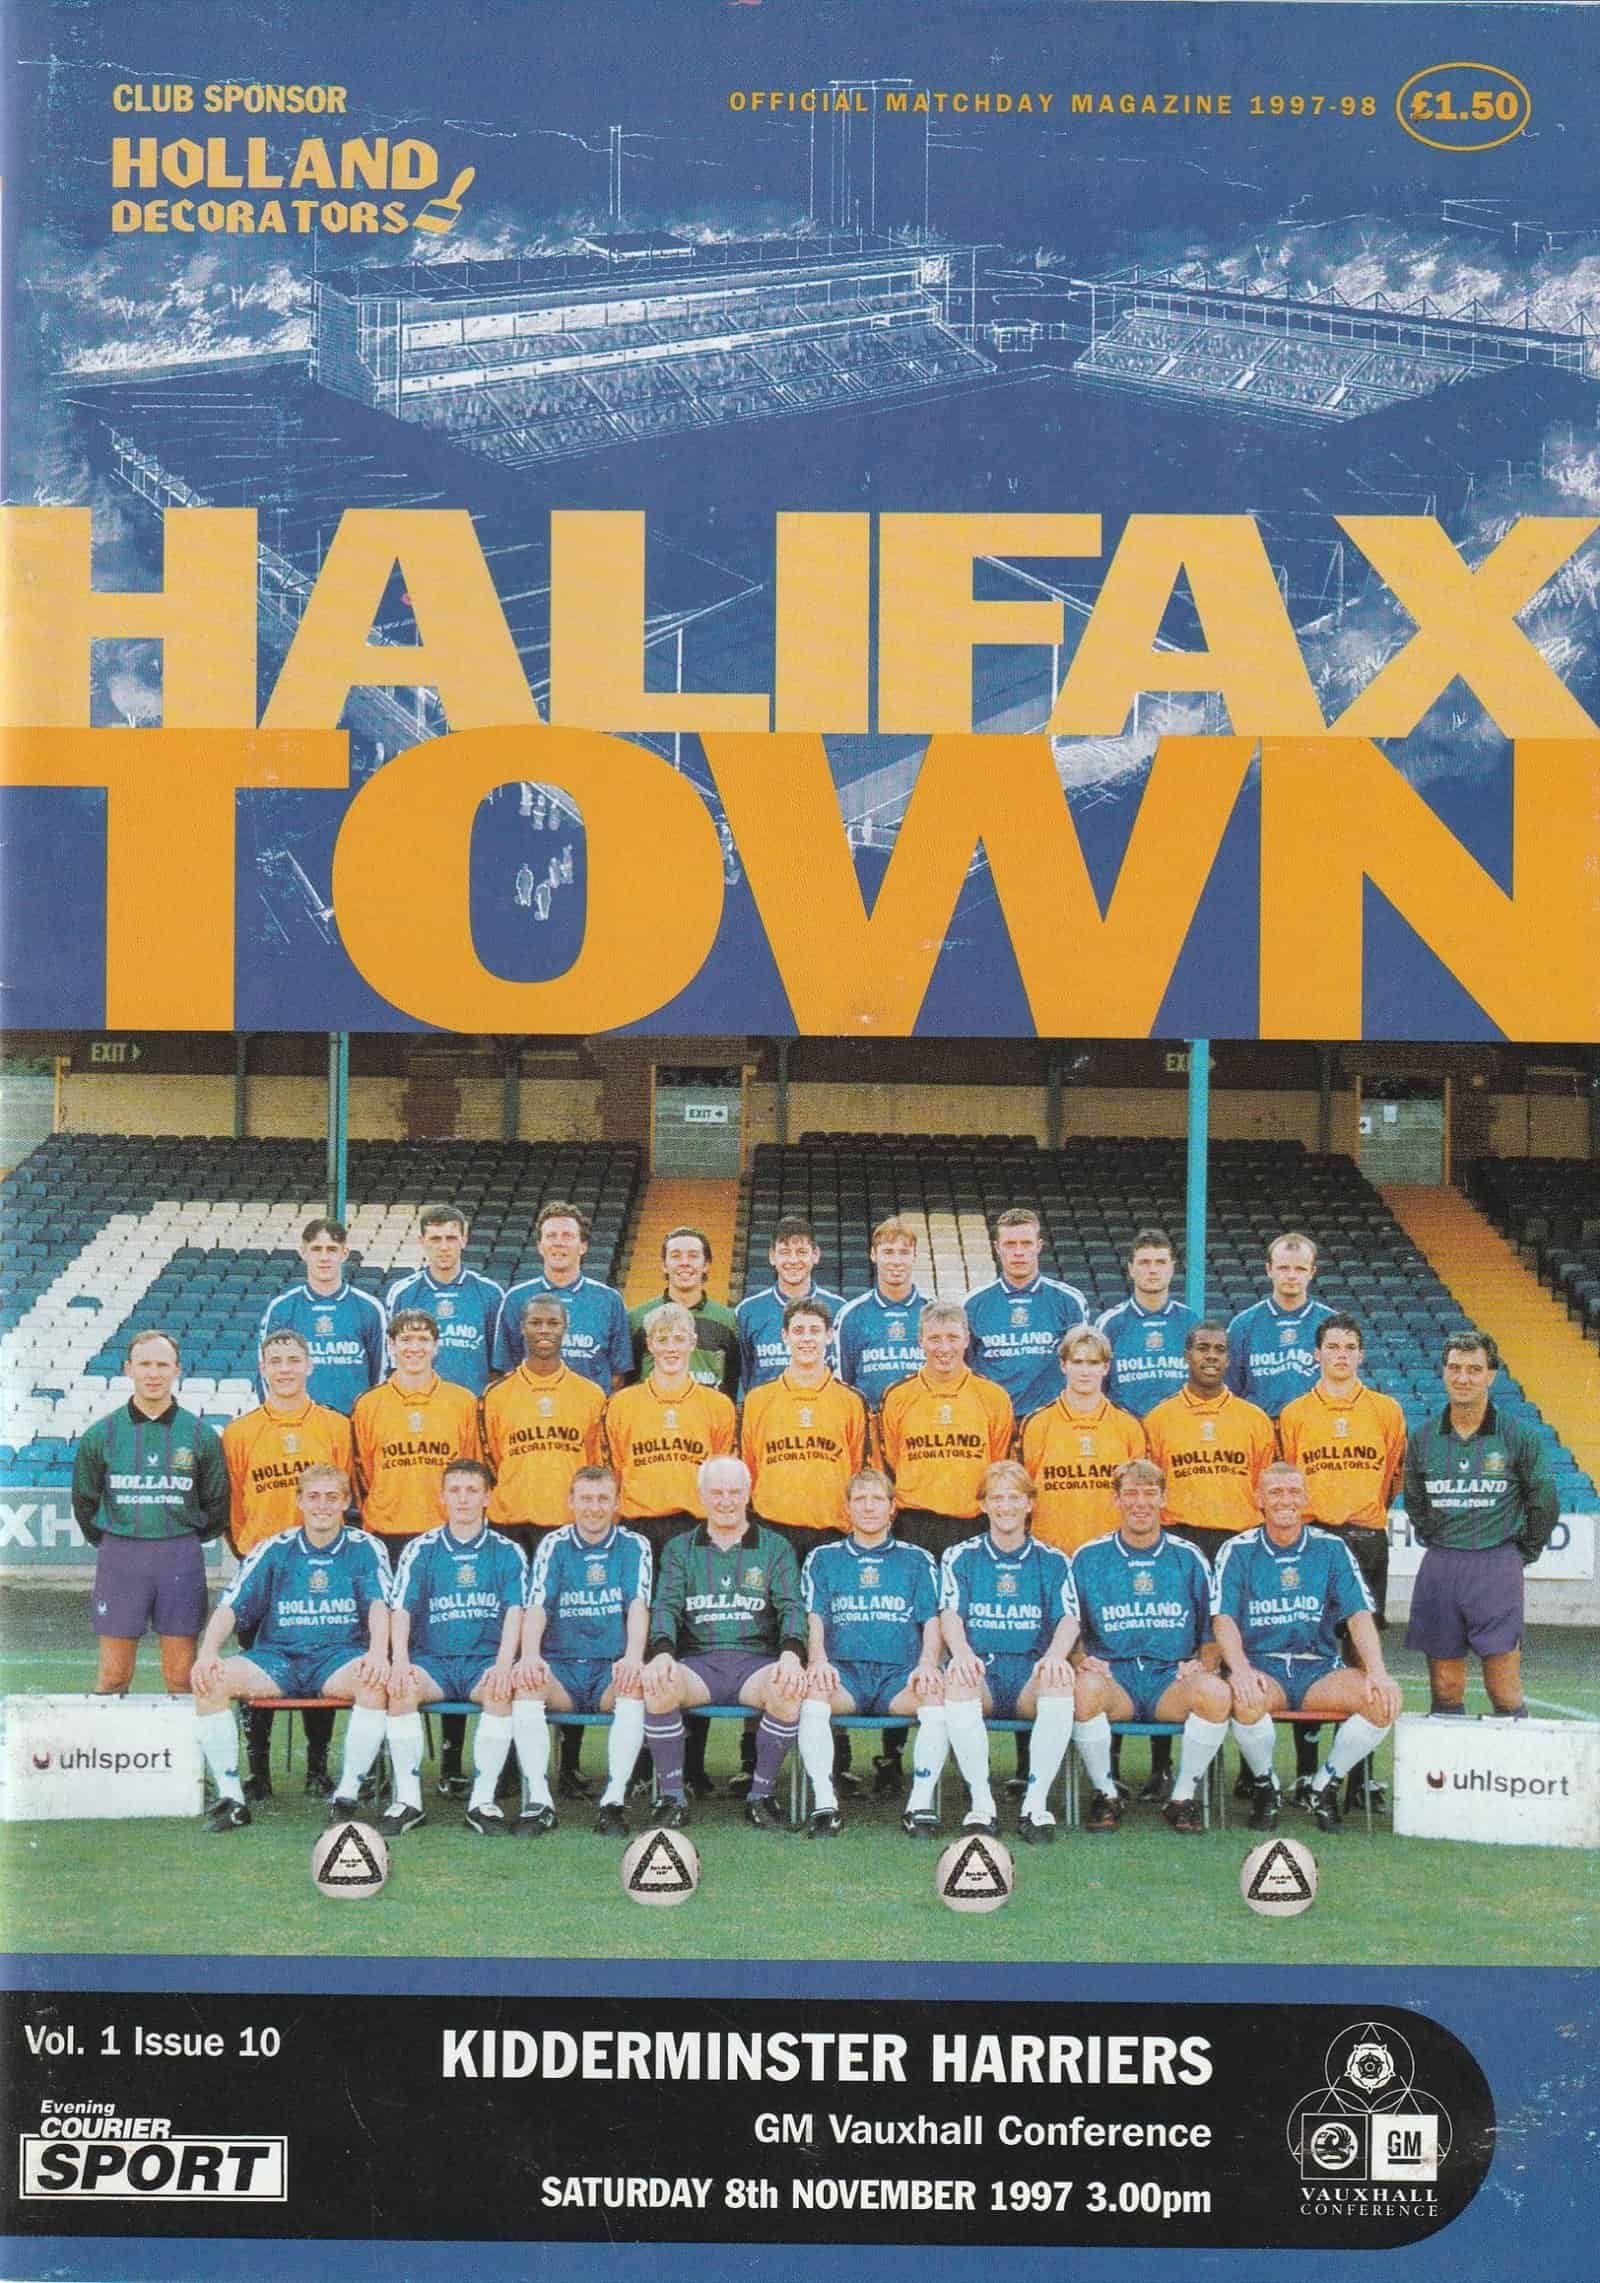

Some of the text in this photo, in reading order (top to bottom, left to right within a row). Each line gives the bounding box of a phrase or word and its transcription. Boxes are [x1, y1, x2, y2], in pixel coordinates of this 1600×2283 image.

[112, 85, 348, 114] CLUB SPONSOR
[728, 91, 1378, 117] OFFICIAL MATCHDAY MAGAZINE 1997-98
[1409, 90, 1520, 122] £1.50
[112, 136, 438, 191] HOLLAND
[112, 200, 409, 233] DECORATORS
[0, 507, 1600, 740] HALIFAX
[0, 723, 1600, 1042] TOWN
[91, 1042, 127, 1063] EXIT
[689, 1108, 713, 1120] EXIT
[632, 1437, 704, 1456] HOLLAND
[765, 1435, 836, 1454] HOLLAND
[905, 1433, 981, 1450] HOLLAND
[1171, 1450, 1246, 1468] HOLLAND
[1303, 1445, 1377, 1465] HOLLAND
[109, 1474, 195, 1492] HOLLAND
[1424, 1479, 1508, 1494] HOLLAND
[278, 1597, 357, 1615] HOLLAND
[430, 1590, 497, 1613] HOLLAND
[1102, 1601, 1182, 1621] HOLLAND
[59, 1746, 173, 1772] uhlsport
[1452, 1769, 1570, 1798] uhlsport
[24, 2025, 282, 2058] Vol. 1 Issue 10
[442, 2028, 1214, 2087] KIDDERMINSTER HARRIERS
[40, 2100, 116, 2117] Evening
[40, 2117, 172, 2140] COURIER
[754, 2112, 1213, 2149] GM Vauxhall Conference
[1387, 2130, 1422, 2157] GM
[37, 2142, 271, 2193] SPORT
[540, 2175, 1213, 2219] SATURDAY 8th NOVEMBER 1997 3.00pm
[1301, 2187, 1439, 2202] VAUXHALL
[1299, 2203, 1440, 2217] CONFERENCE
